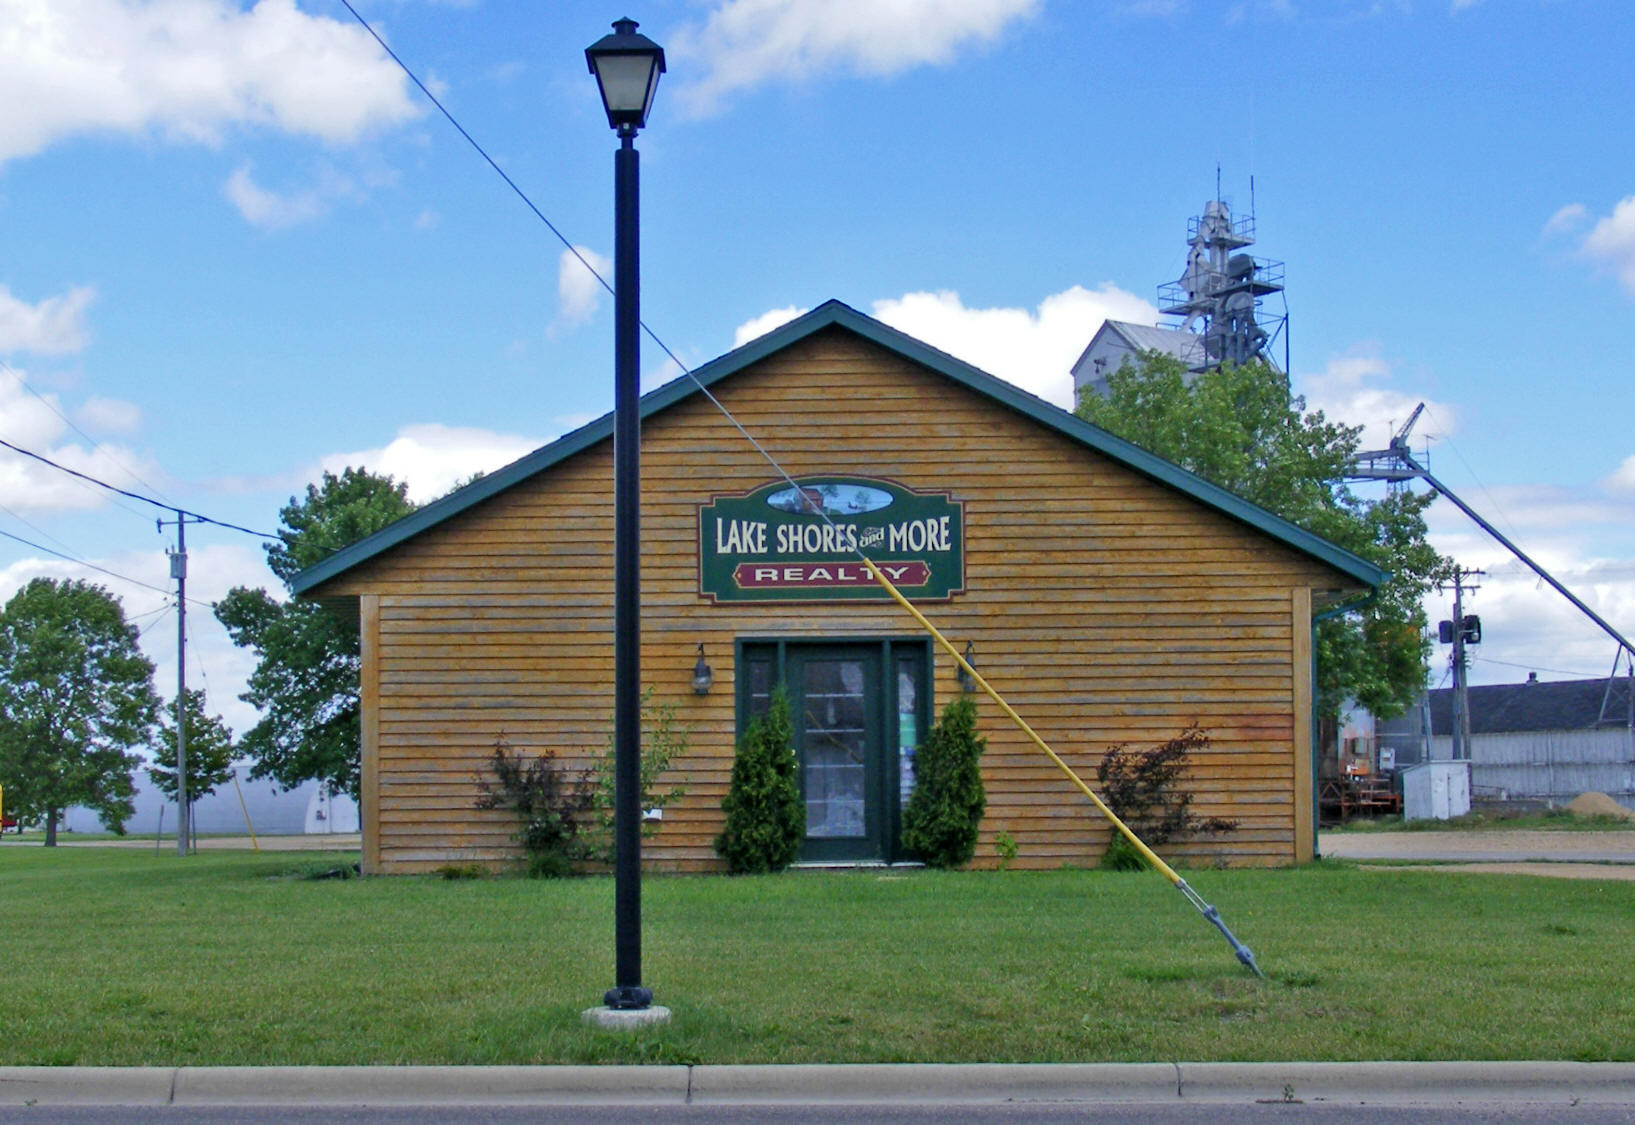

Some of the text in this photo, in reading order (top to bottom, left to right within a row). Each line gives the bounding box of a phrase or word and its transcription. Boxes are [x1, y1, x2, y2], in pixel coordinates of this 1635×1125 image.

[717, 516, 951, 554] LAKE SHORES and MORE
[755, 567, 909, 581] REALTY
